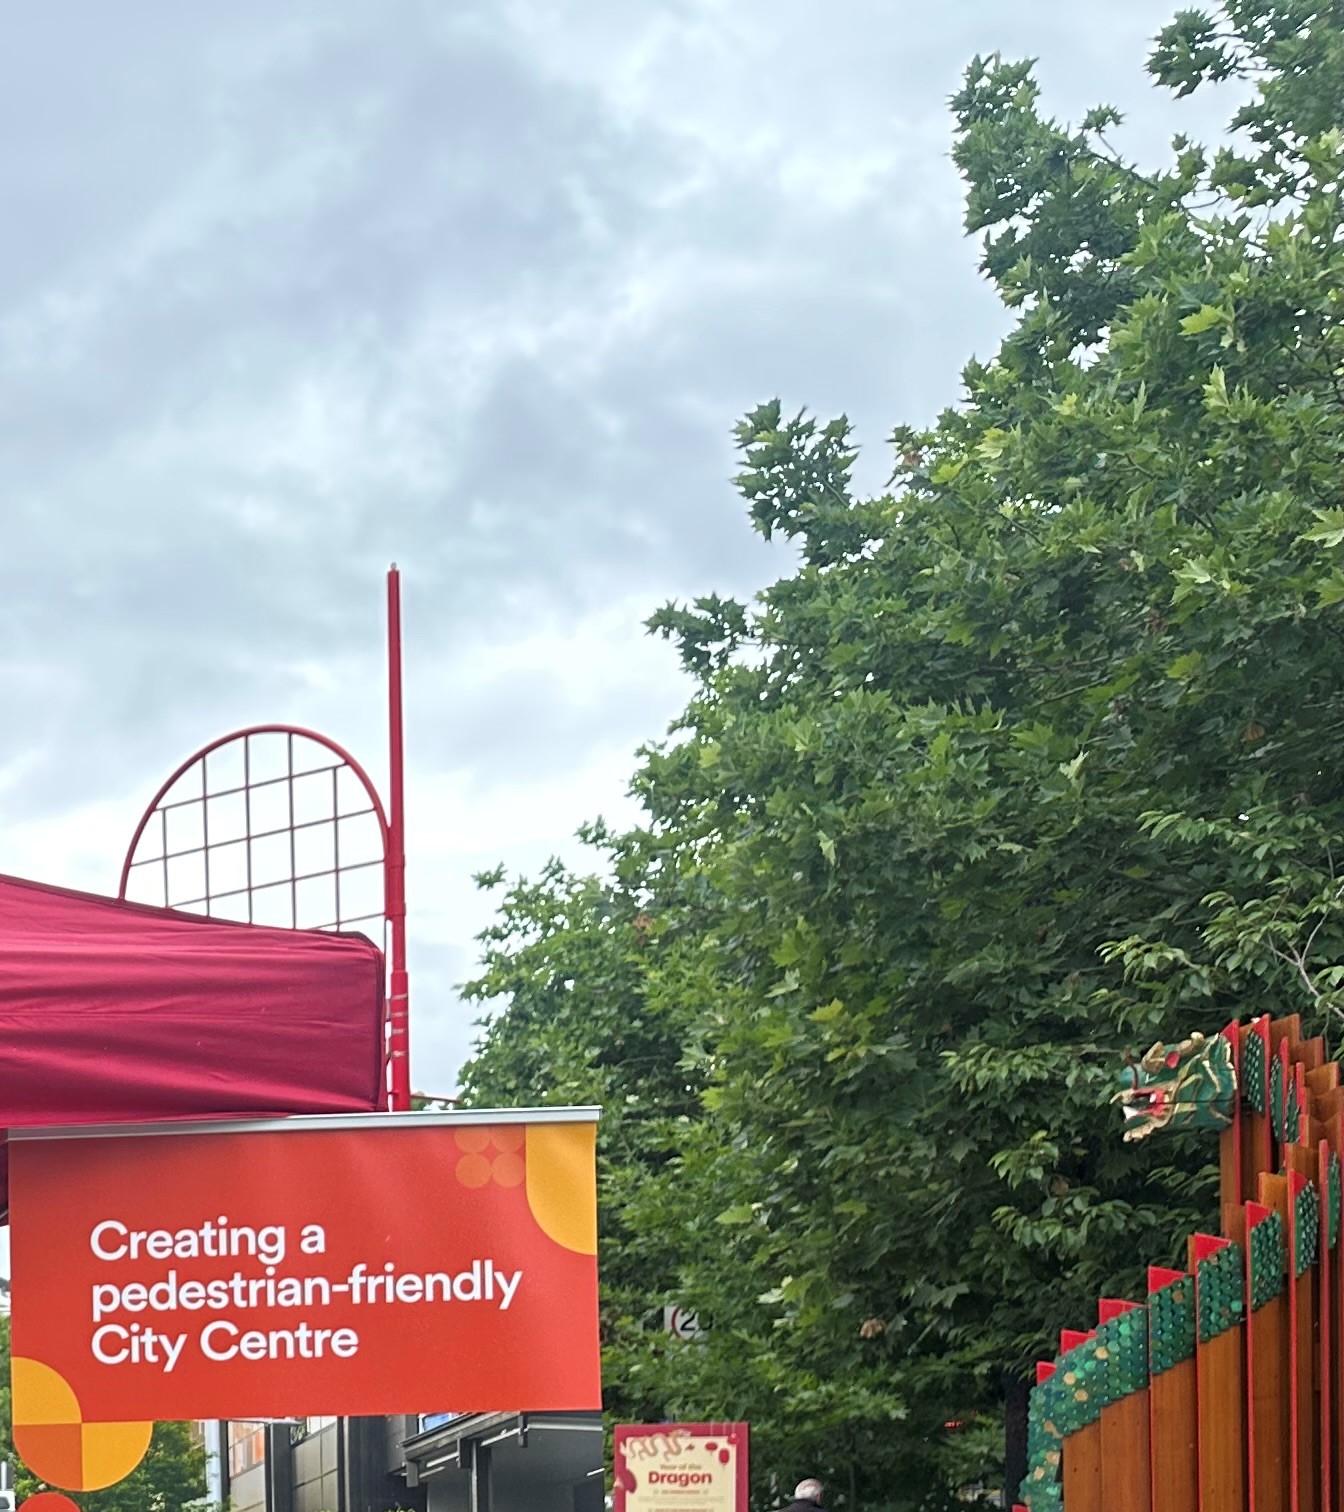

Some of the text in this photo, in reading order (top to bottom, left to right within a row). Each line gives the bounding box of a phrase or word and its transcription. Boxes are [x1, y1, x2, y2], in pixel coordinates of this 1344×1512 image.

[90, 1215, 326, 1264] Creating a
[92, 1259, 523, 1321] pedestrian-friendly
[91, 1320, 359, 1372] City Centre
[648, 1470, 713, 1488] Dragon
